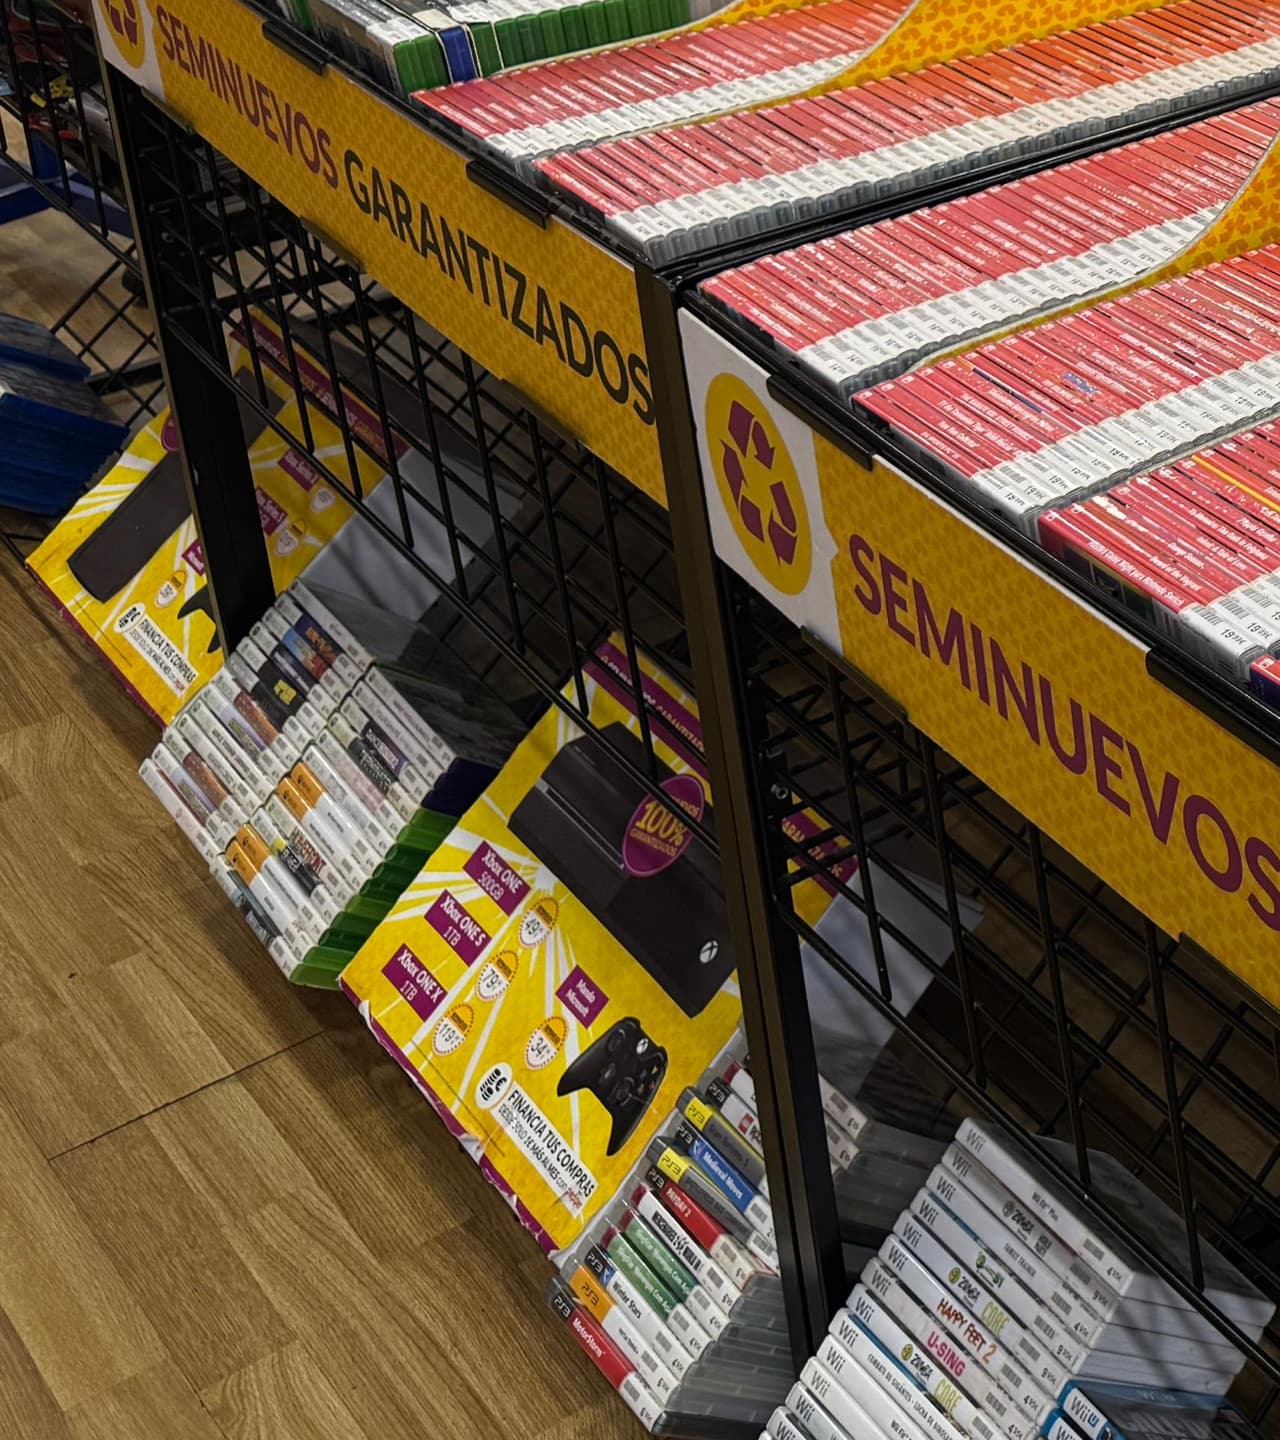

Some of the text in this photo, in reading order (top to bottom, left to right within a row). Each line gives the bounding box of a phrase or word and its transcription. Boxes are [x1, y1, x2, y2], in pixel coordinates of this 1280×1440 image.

[156, 7, 656, 424] SEMINUEVOS GARANTIZADOS
[482, 850, 521, 894] Xbox ONE
[508, 1090, 595, 1198] FINANCIA TUS COMPRAS
[937, 1177, 958, 1202] Wii
[937, 1298, 988, 1350] HAPPY FEET
[926, 1331, 966, 1376] U-SING
